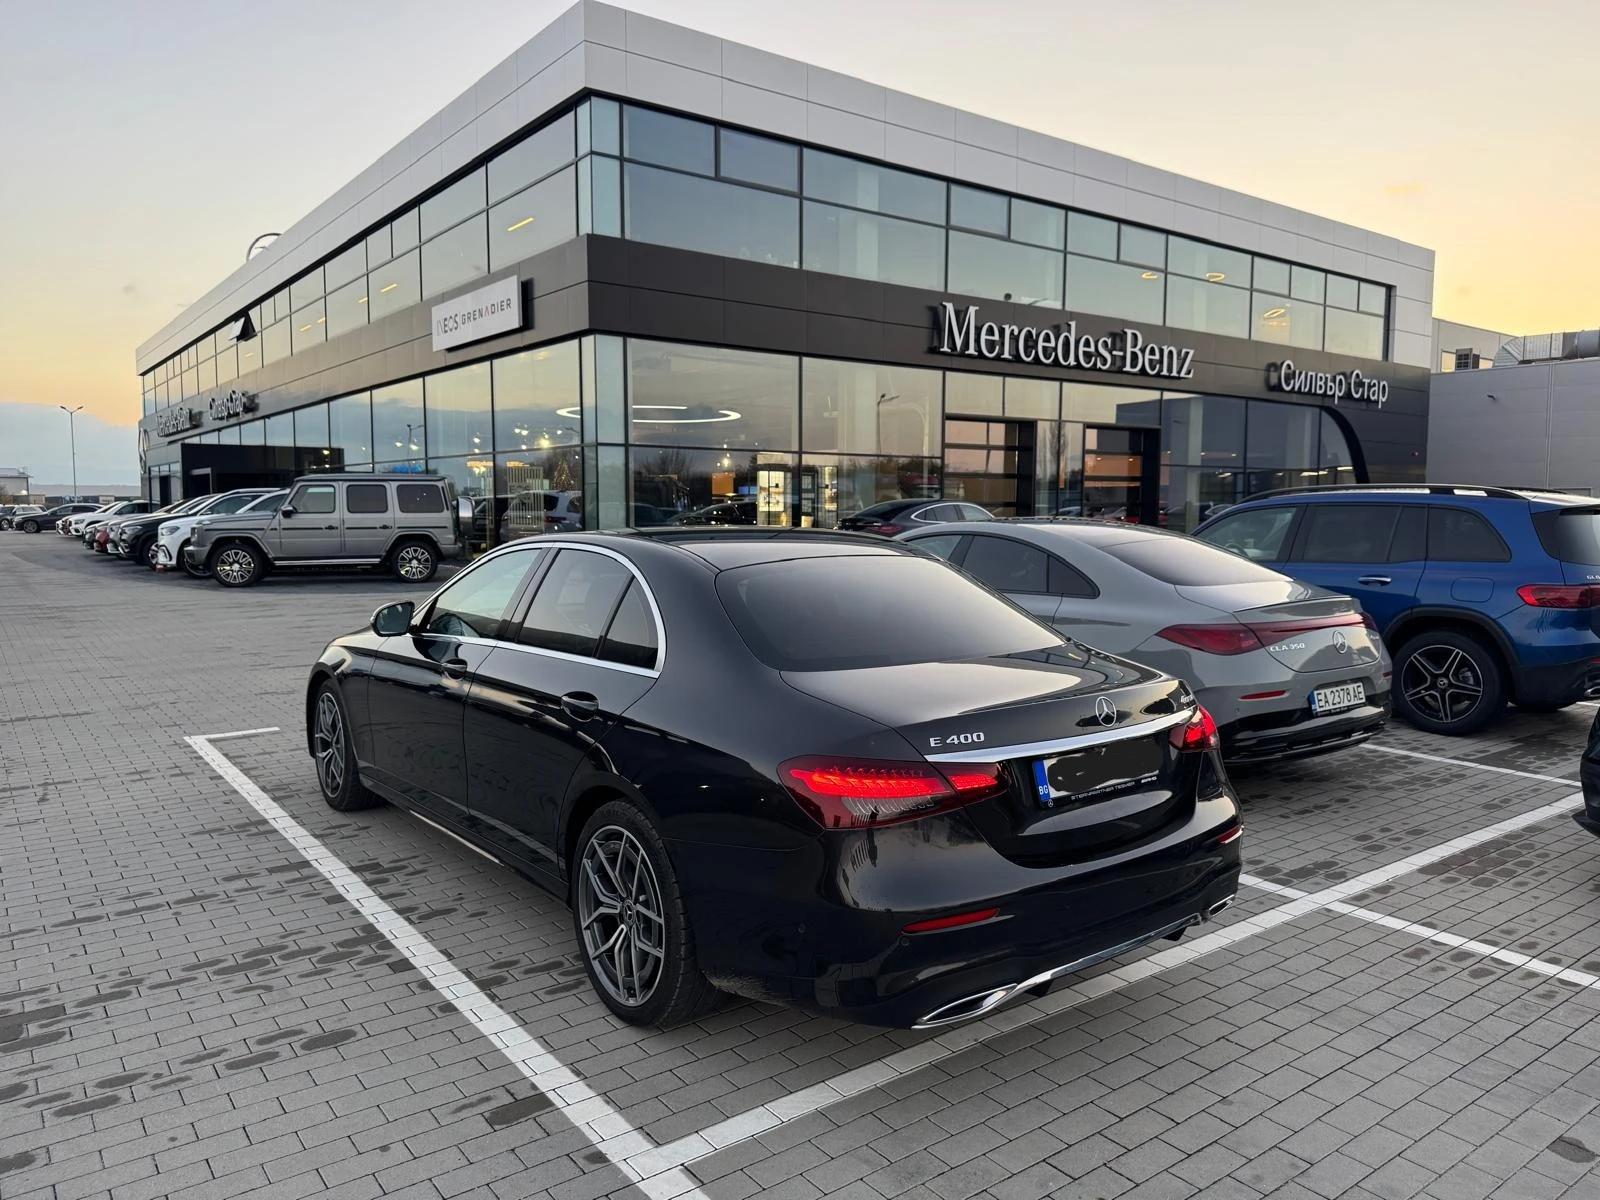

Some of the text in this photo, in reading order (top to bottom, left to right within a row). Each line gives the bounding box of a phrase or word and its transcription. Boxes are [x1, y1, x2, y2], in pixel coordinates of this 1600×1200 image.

[461, 298, 512, 325] GRENADIER
[940, 301, 1195, 379] Mercedes-Benz
[1281, 360, 1389, 409] Силвър Стар
[1270, 642, 1305, 653] CLA 350
[1316, 690, 1330, 709] EA
[1330, 687, 1352, 708] 2378
[1352, 685, 1364, 702] AE
[929, 732, 985, 747] E 400
[1038, 785, 1049, 795] BG
